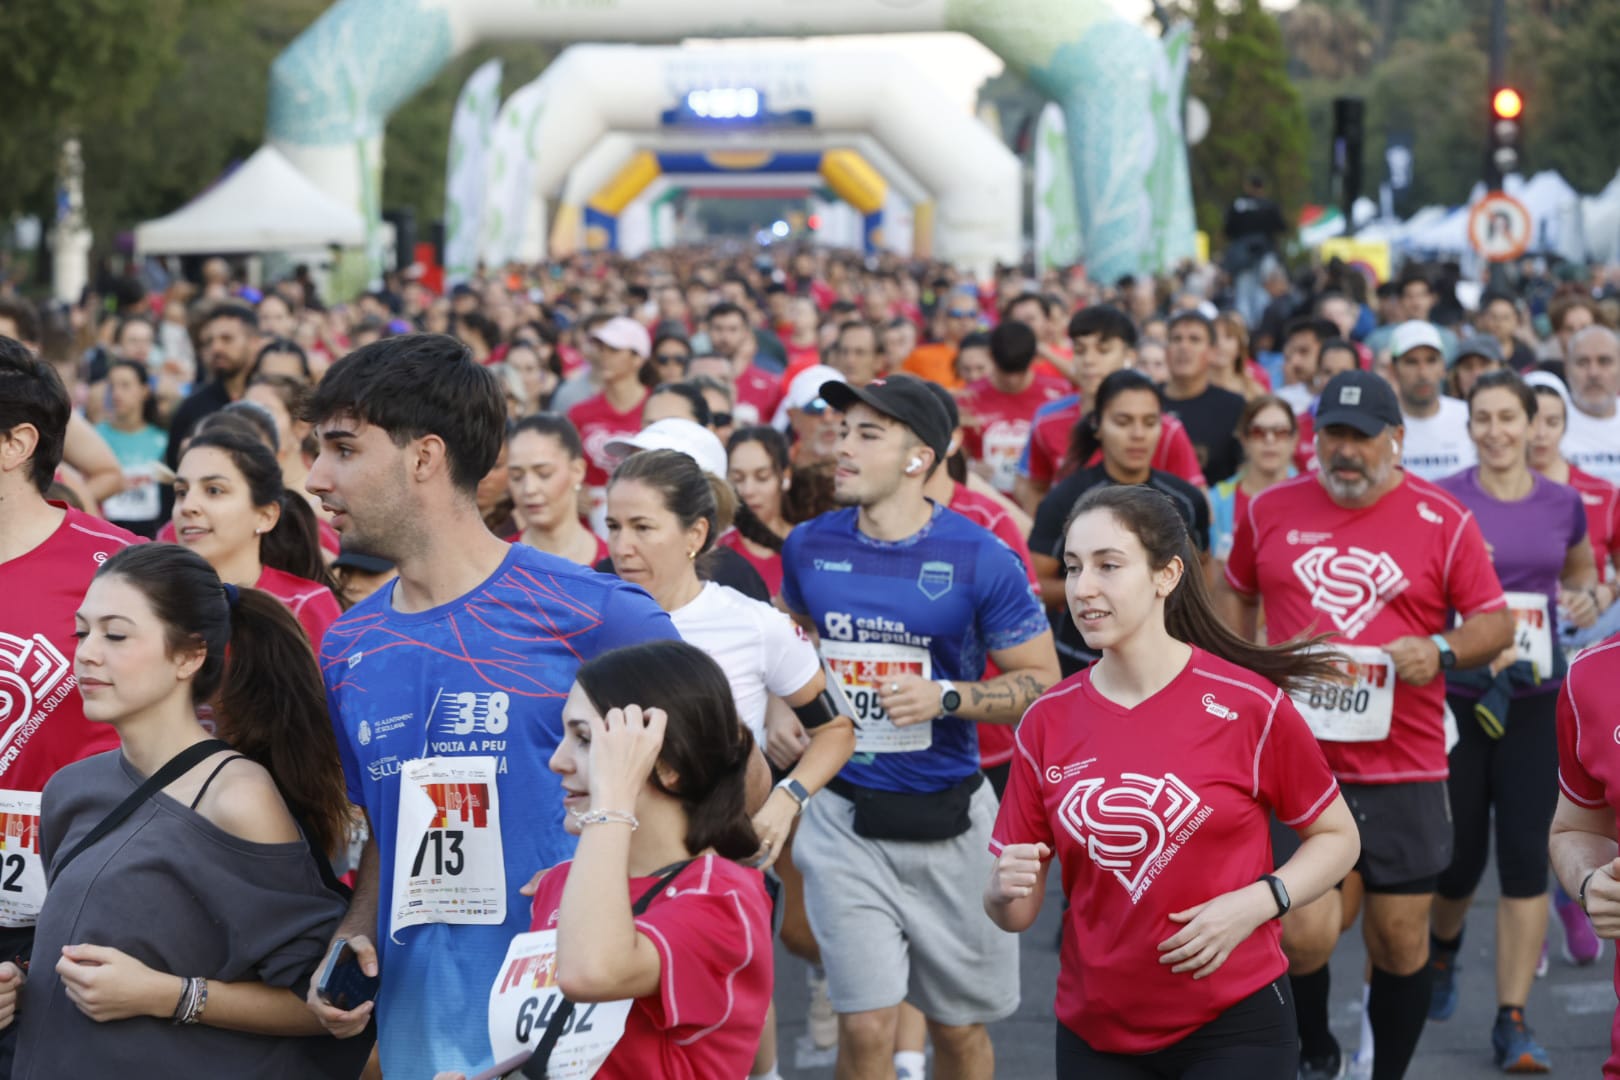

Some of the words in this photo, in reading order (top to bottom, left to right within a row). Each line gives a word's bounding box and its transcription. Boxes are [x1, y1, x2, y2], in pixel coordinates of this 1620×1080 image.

[856, 616, 905, 632] caixa
[857, 629, 932, 647] popular
[14, 709, 49, 749] PERSONA
[42, 673, 79, 713] SOLIDARI
[448, 691, 510, 736] 38
[431, 741, 466, 753] VOLTA
[469, 741, 478, 752] A
[482, 740, 507, 751] PEU
[0, 853, 26, 893] 2
[1131, 876, 1153, 905] SUPER
[1148, 842, 1181, 879] PERSONA
[1175, 805, 1215, 845] SOLIDARIA
